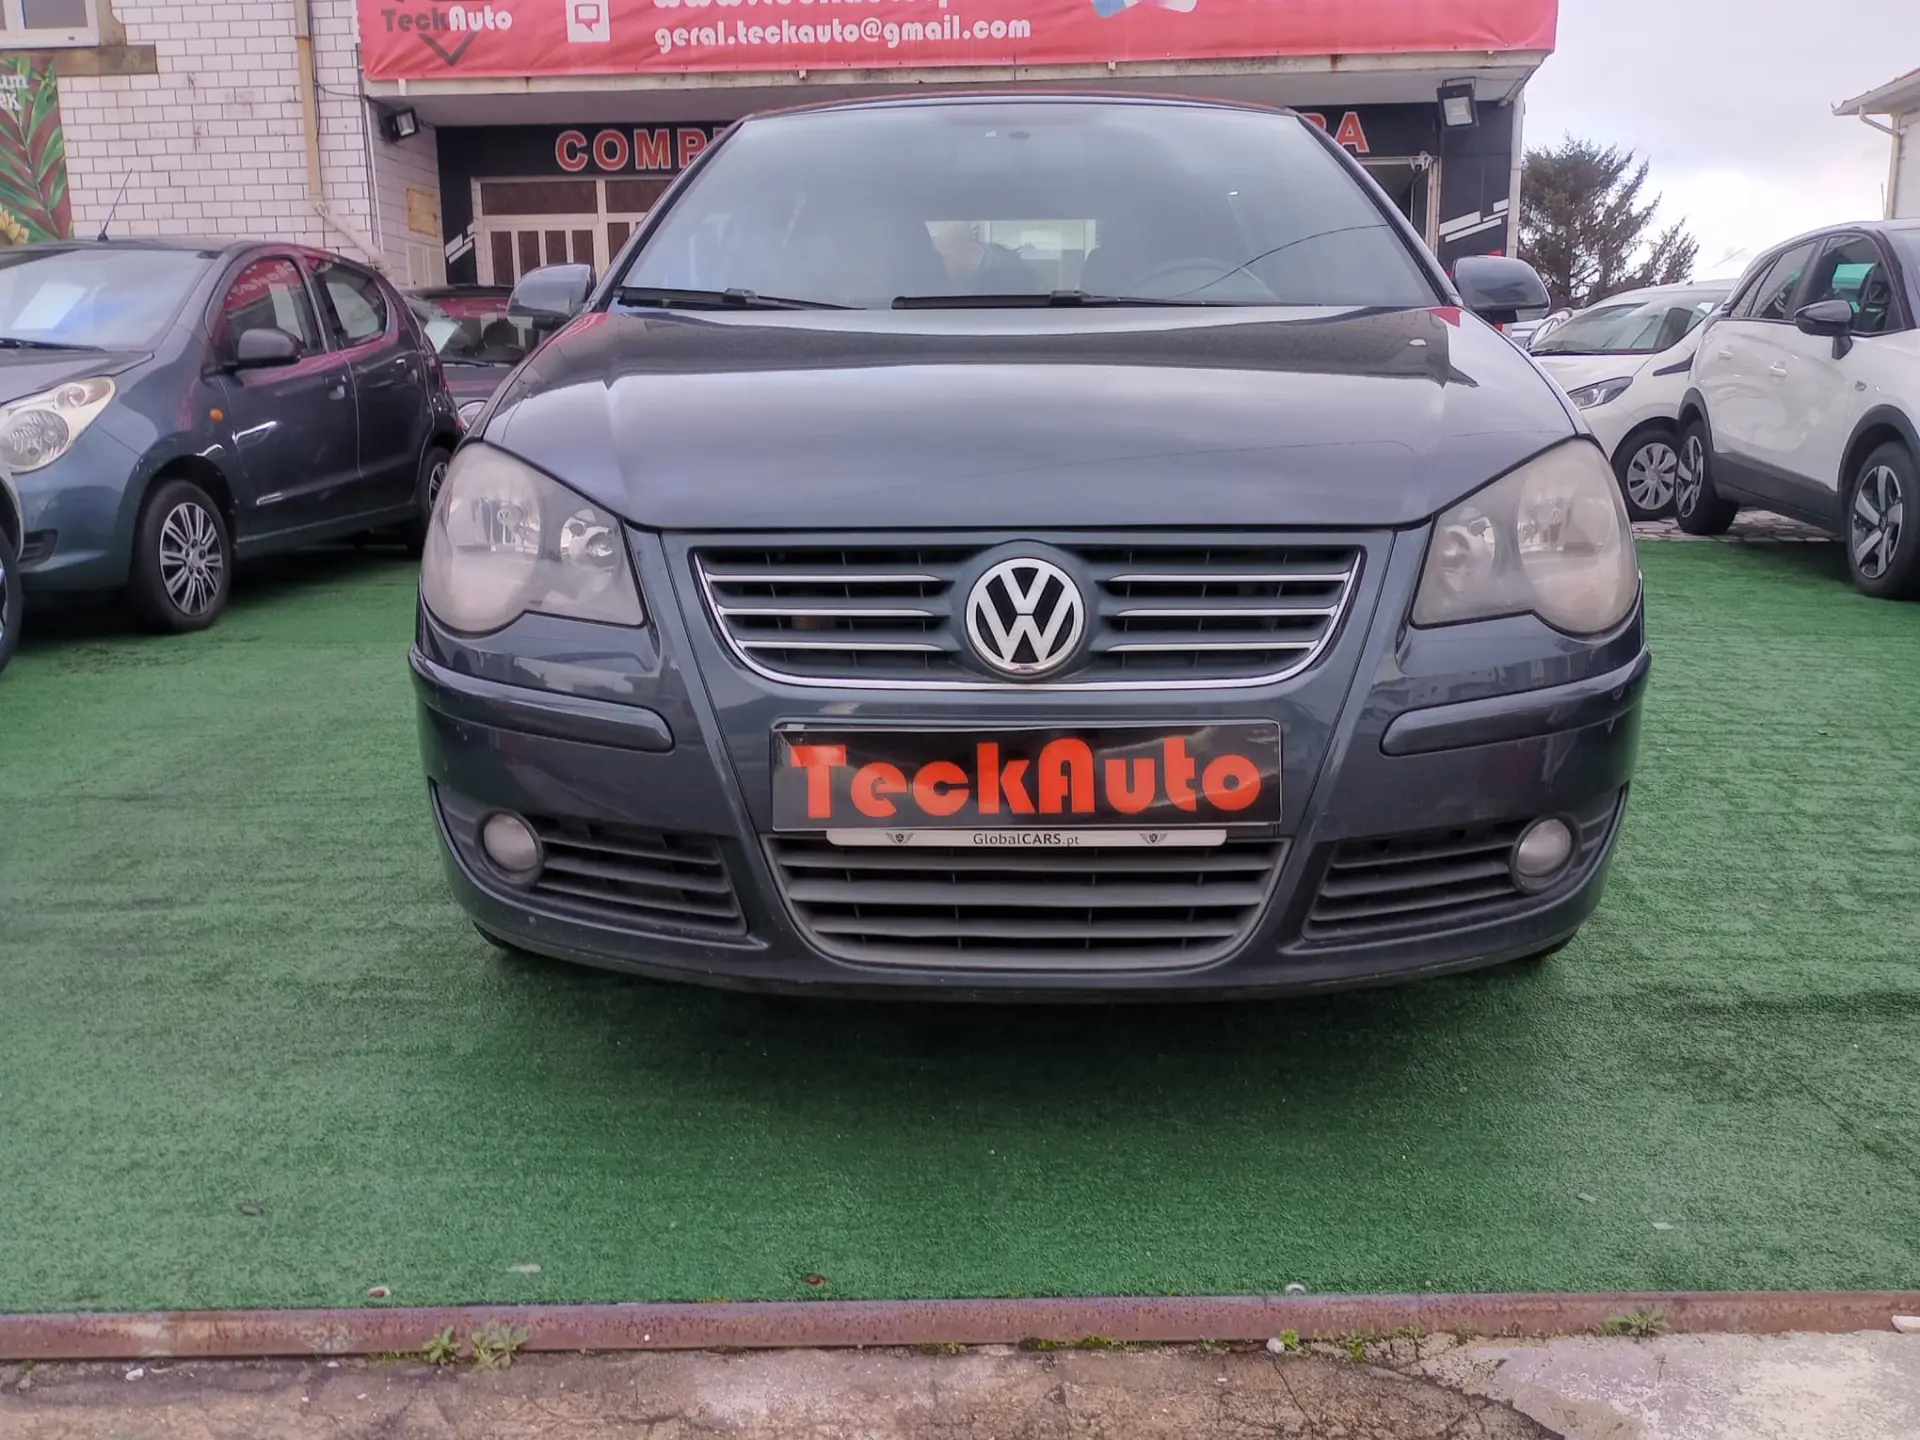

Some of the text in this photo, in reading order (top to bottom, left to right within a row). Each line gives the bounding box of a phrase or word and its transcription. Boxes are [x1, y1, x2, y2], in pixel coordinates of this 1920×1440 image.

[381, 5, 513, 32] TeckAuto
[654, 15, 1031, 54] geral.teckauto@gmail.com
[555, 127, 727, 172] COMP
[790, 736, 1261, 818] TeckAuto
[973, 833, 1080, 848] GlobalCARS.pt
